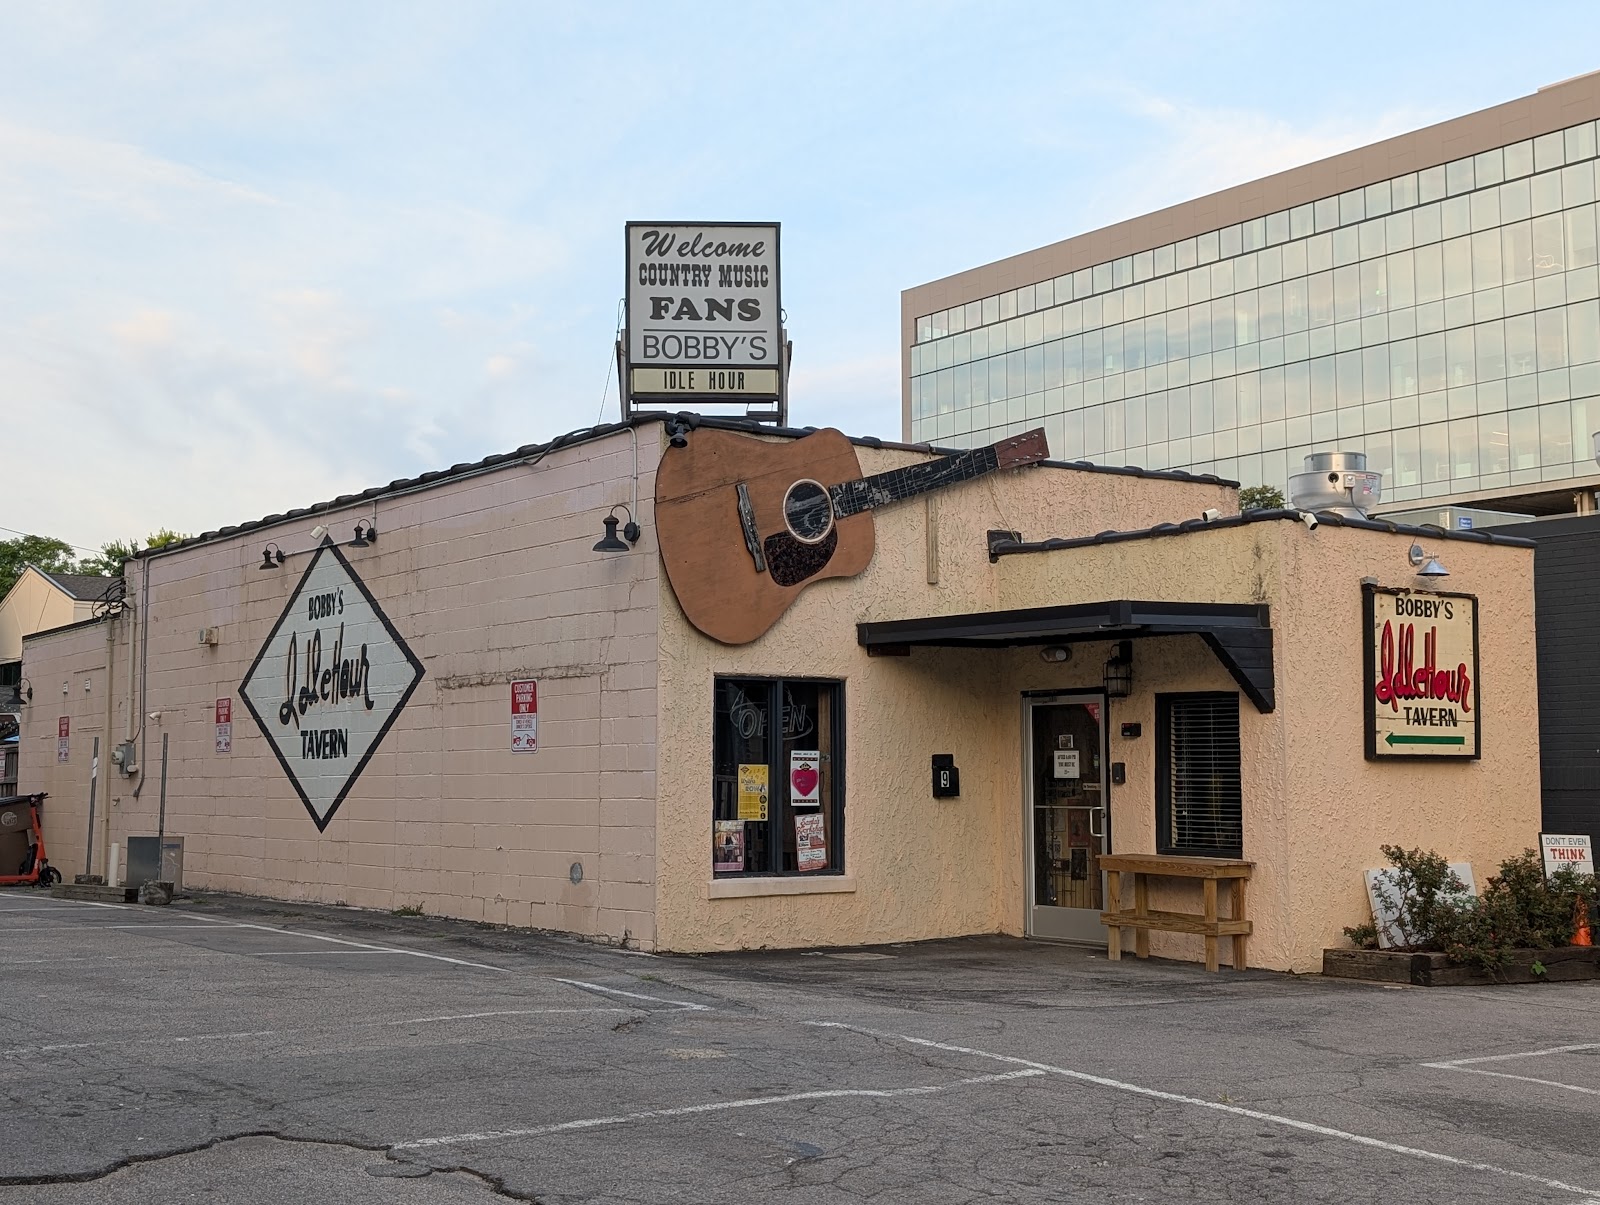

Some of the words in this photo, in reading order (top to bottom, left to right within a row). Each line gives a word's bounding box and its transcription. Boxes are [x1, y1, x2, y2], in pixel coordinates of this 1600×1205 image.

[642, 231, 765, 258] Welcome
[639, 263, 711, 287] COUNTRY
[719, 265, 768, 287] MUSIC
[650, 297, 761, 321] FANS
[643, 335, 767, 360] BOBBY'S
[664, 371, 695, 389] IDLE
[709, 372, 745, 390] HOUR
[308, 587, 344, 621] BOBBY'S
[1396, 598, 1453, 619] BOBBY'S
[1403, 707, 1457, 727] TAVERN
[301, 729, 348, 760] TAVERN
[942, 771, 949, 787] 9
[1568, 837, 1587, 846] EVEN
[1550, 848, 1586, 860] THINK
